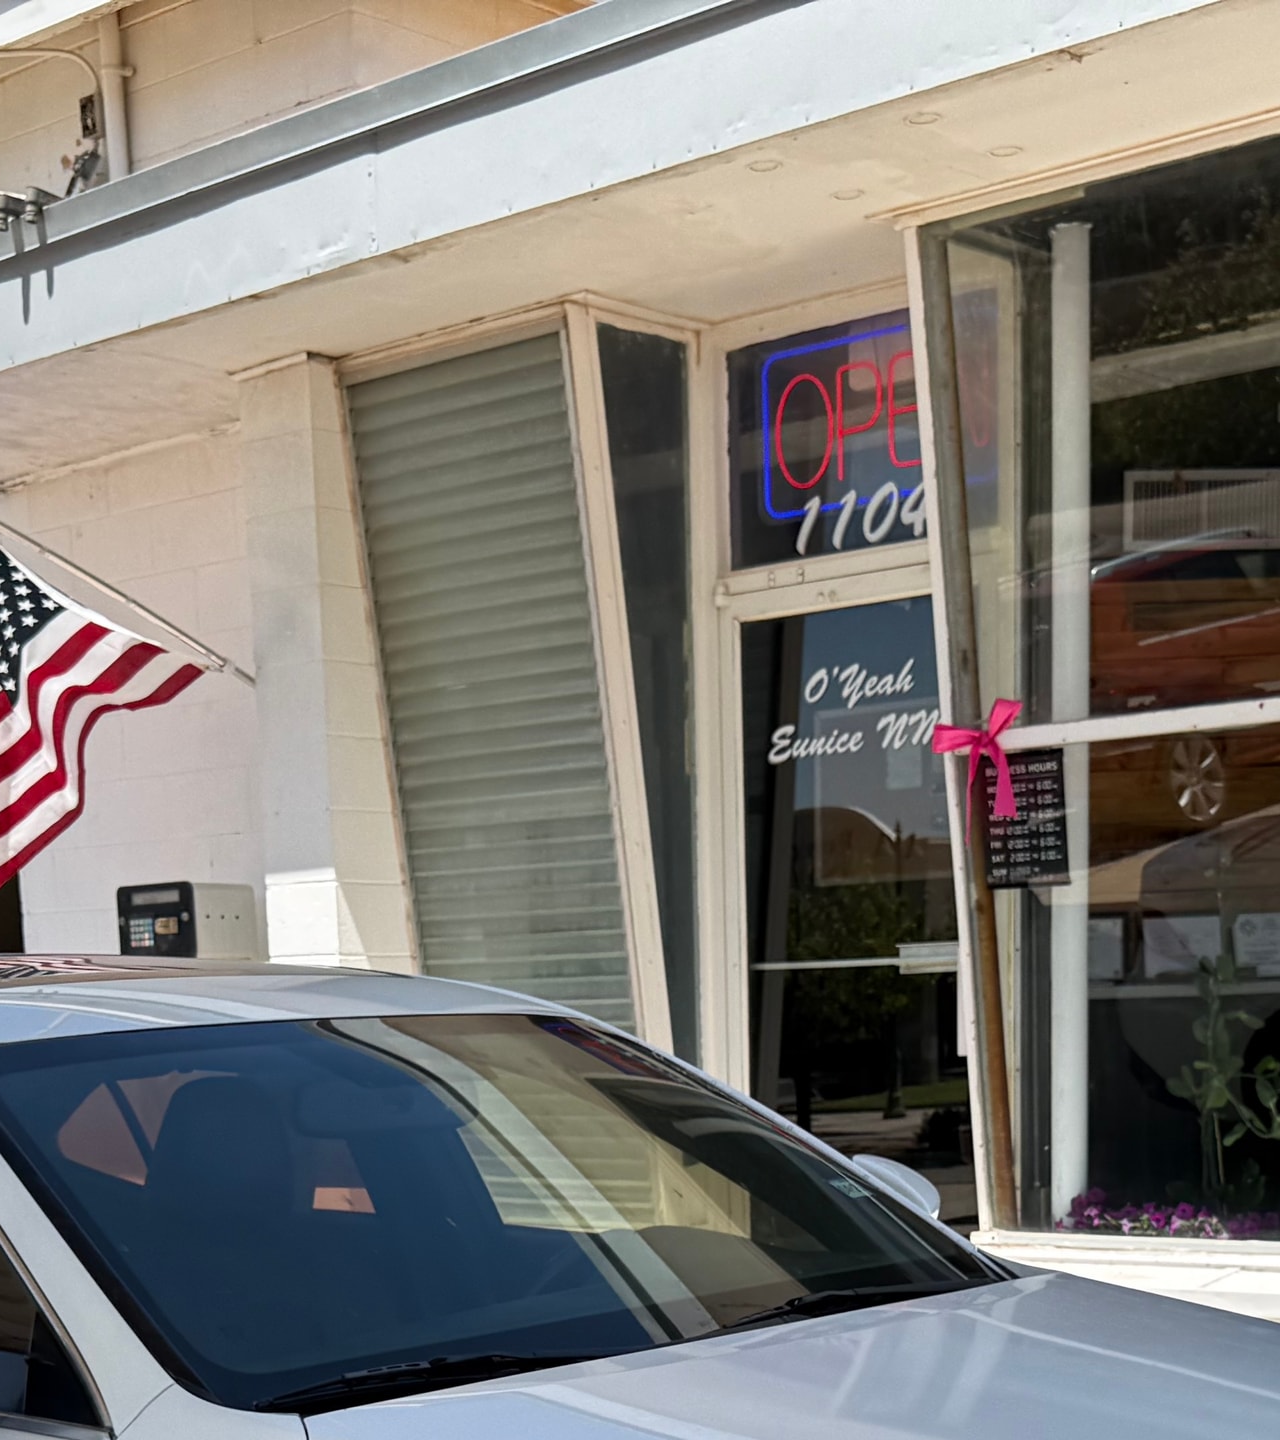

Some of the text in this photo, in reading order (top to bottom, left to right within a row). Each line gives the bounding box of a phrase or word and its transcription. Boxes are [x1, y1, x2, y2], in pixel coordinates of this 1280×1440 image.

[795, 481, 927, 556] 1104
[803, 657, 915, 710] O'Yeah
[767, 724, 865, 765] Eunice
[985, 761, 1058, 777] BUESS HOURS
